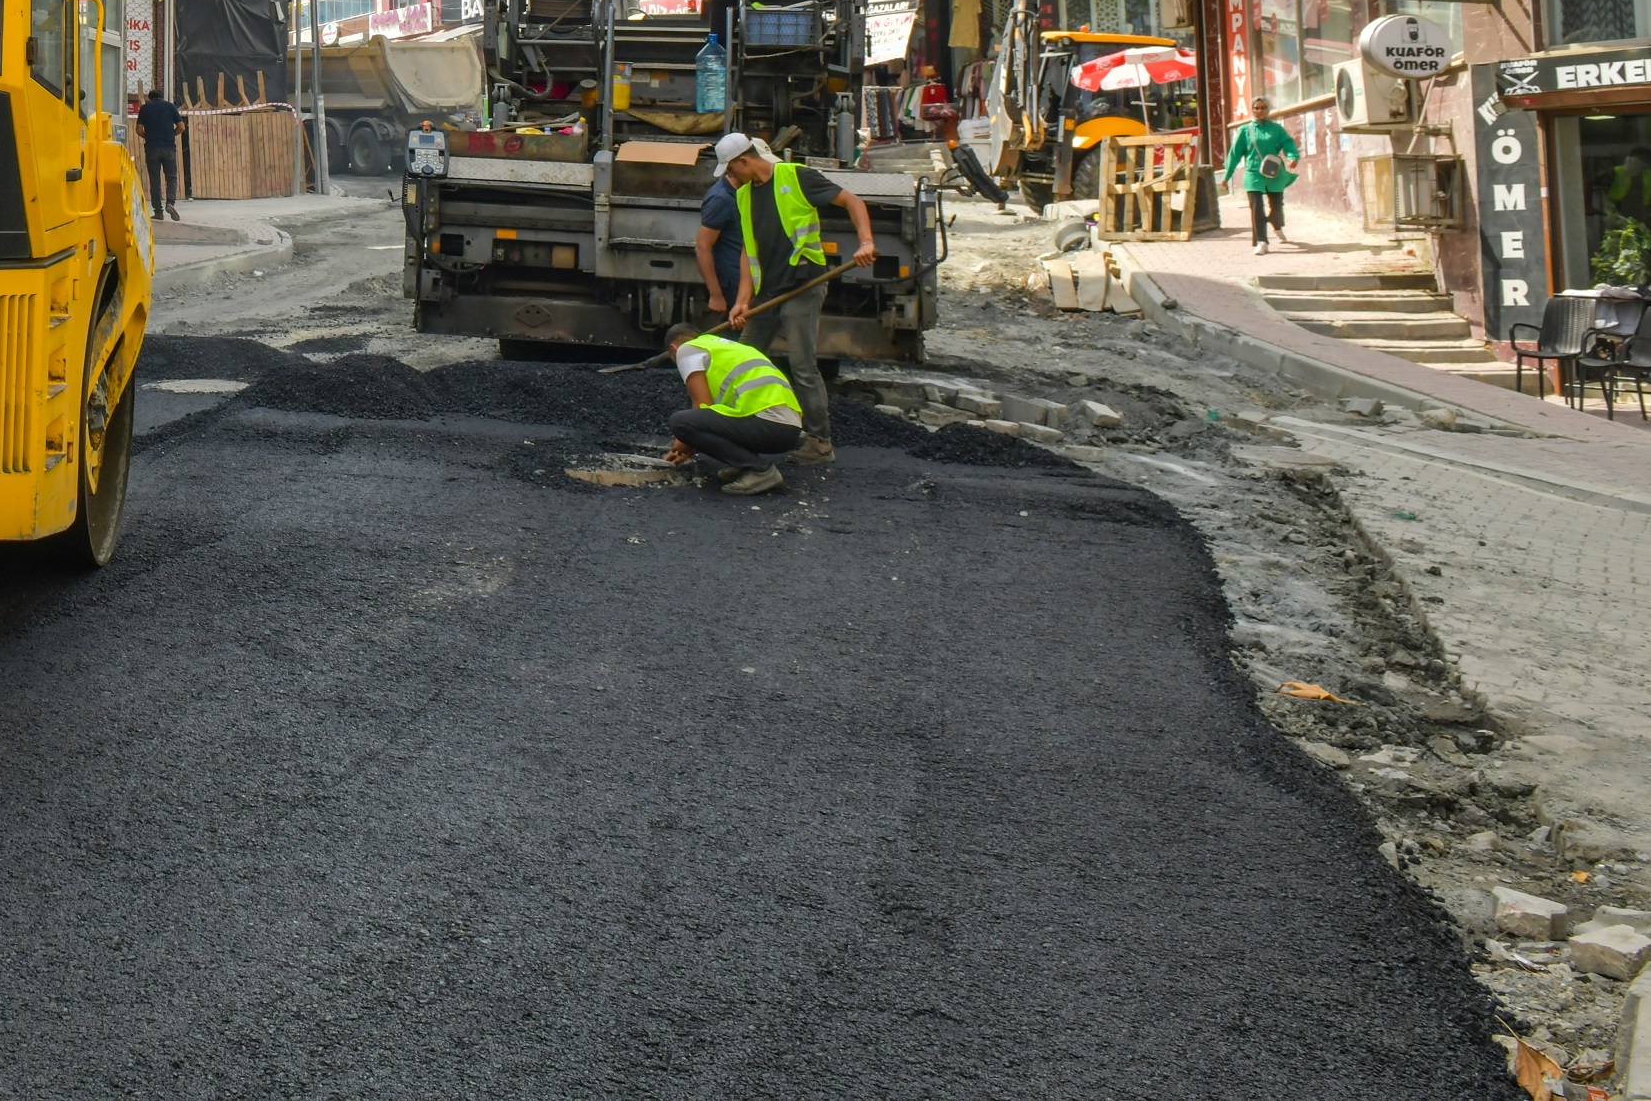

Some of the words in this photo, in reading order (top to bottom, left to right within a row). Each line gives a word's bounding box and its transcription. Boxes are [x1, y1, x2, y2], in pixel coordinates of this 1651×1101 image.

[868, 1, 909, 14] ĞAZALARI
[1385, 45, 1445, 58] KUAFÖR
[127, 58, 137, 71] Rİ
[1491, 128, 1531, 307] ÖMER
